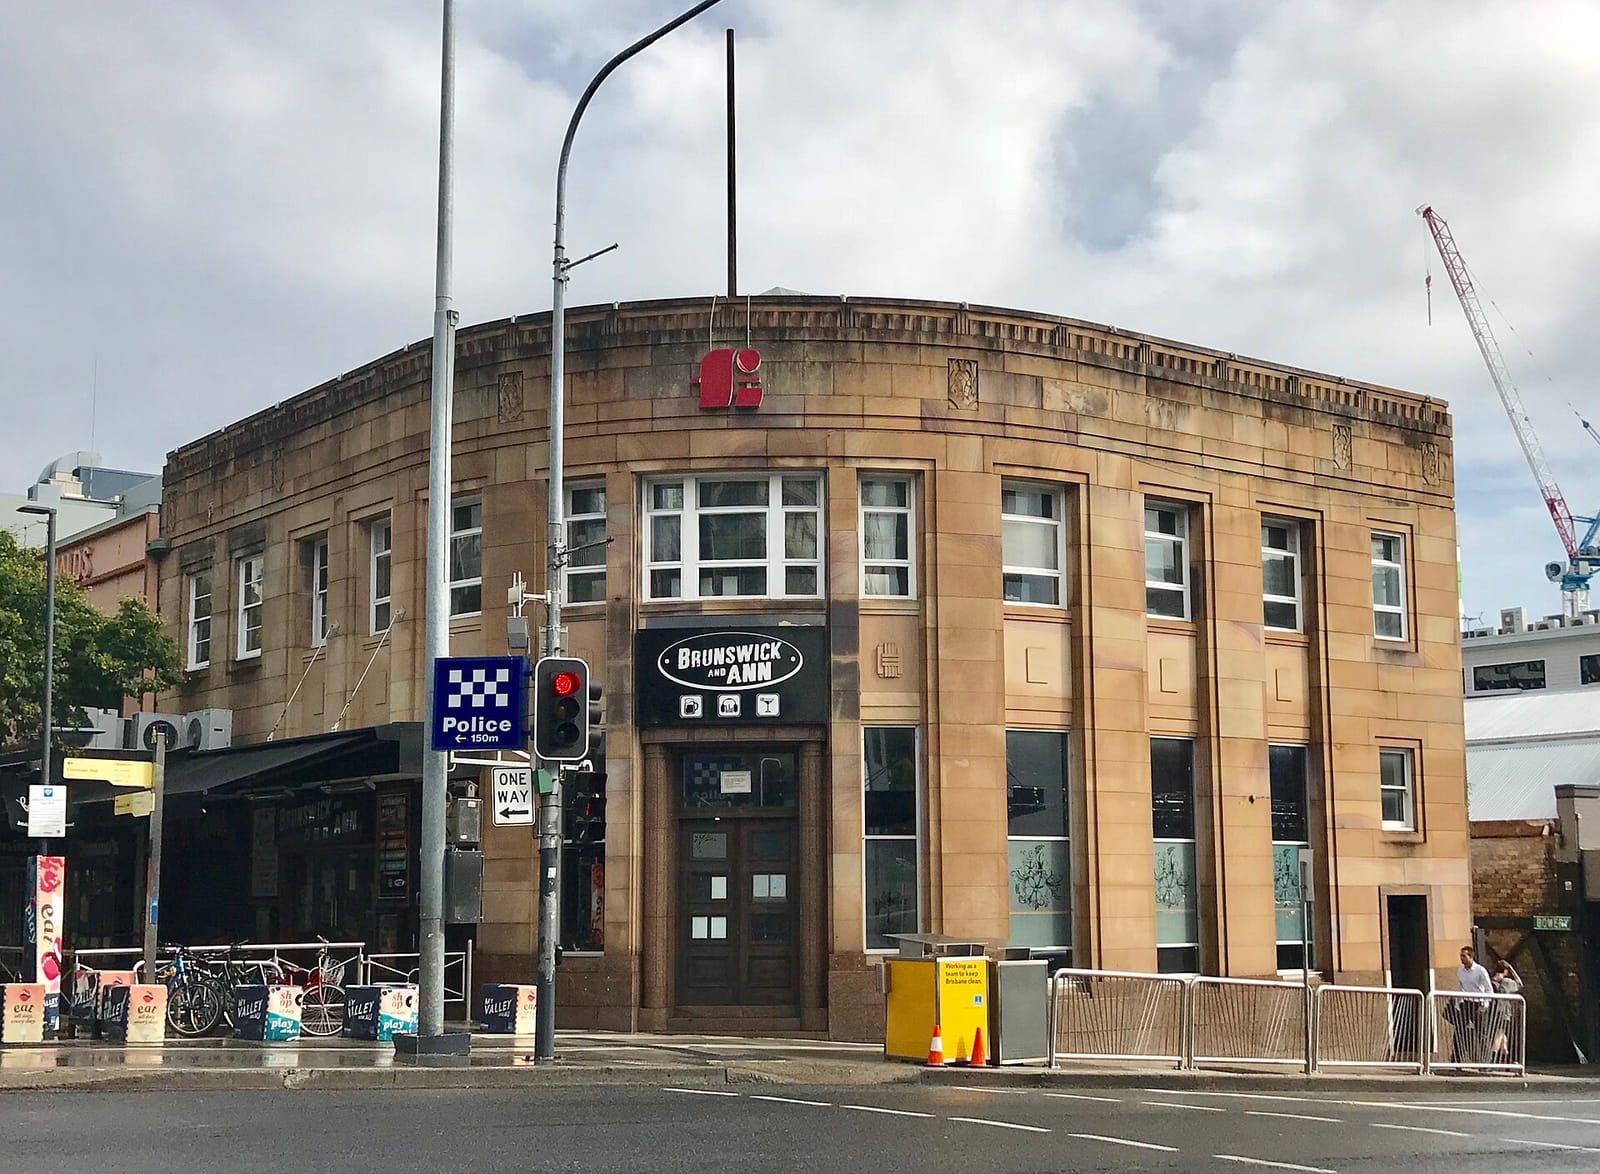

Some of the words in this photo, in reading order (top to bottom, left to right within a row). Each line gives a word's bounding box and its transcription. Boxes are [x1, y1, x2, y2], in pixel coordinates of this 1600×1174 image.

[678, 641, 782, 670] BRUNSWICK
[707, 668, 727, 678] AND
[726, 661, 772, 685] ANN
[442, 716, 512, 733] Police
[471, 734, 499, 743] 150m
[499, 772, 527, 786] ONE
[497, 790, 529, 804] WAY
[41, 903, 54, 945] eat
[13, 1004, 34, 1013] eat
[137, 1005, 157, 1014] eat
[237, 999, 263, 1018] VALLEY
[484, 998, 513, 1015] VALLEY
[270, 1017, 294, 1030] play
[383, 1019, 404, 1031] play
